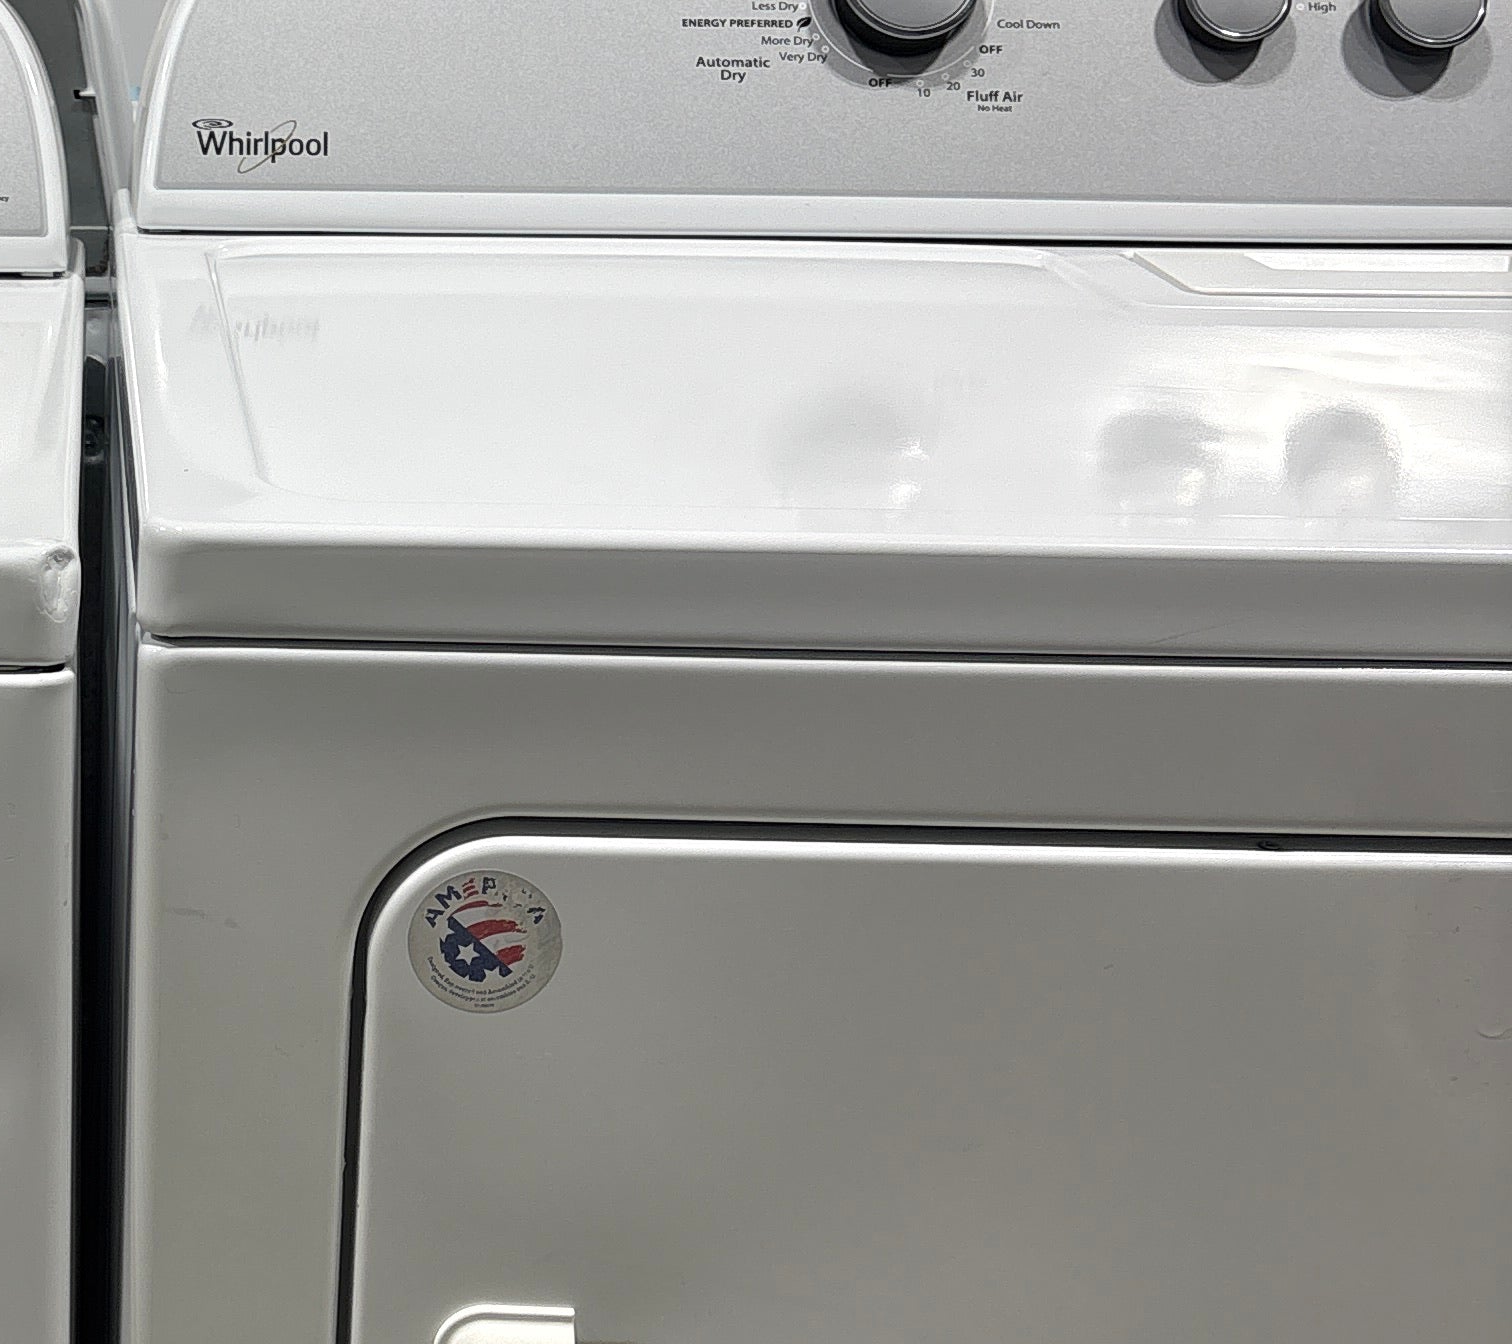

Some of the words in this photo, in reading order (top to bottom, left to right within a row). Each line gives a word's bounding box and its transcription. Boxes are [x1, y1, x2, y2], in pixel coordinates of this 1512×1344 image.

[752, 2, 775, 11] Less
[777, 2, 799, 13] Dry
[1308, 2, 1336, 13] High
[682, 19, 726, 28] ENERGY
[730, 19, 793, 28] PREFERRED
[997, 20, 1022, 29] Cool
[1026, 20, 1060, 30] Down
[761, 36, 789, 45] More
[792, 36, 813, 48] Dry
[980, 45, 1002, 54] OFF
[696, 56, 770, 68] Automatic
[779, 52, 804, 63] Very
[806, 52, 827, 63] Dry
[720, 69, 746, 83] Dry
[971, 68, 984, 77] 30
[869, 79, 892, 88] OFF
[947, 82, 960, 90] 20
[917, 89, 930, 97] 10
[967, 90, 998, 102] Fluff
[1002, 90, 1023, 102] Air
[197, 131, 328, 163] Whirlpool
